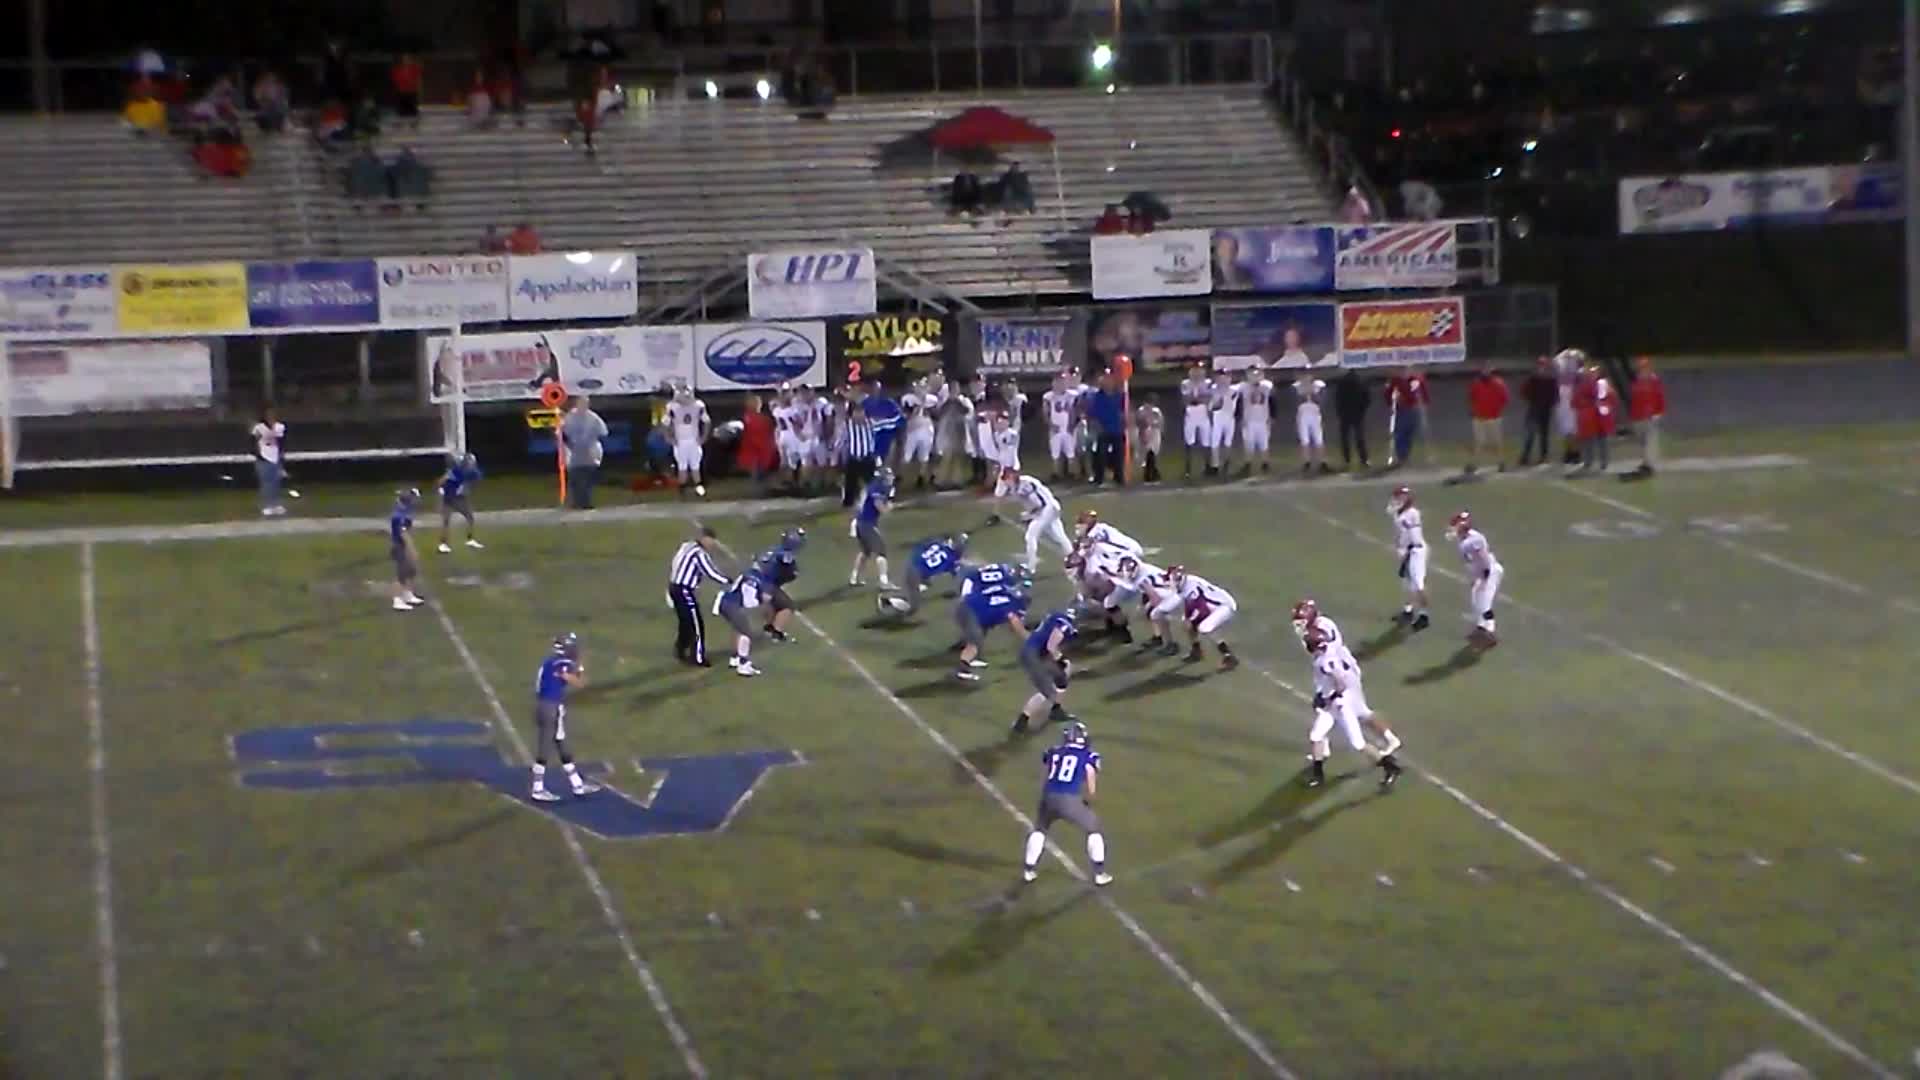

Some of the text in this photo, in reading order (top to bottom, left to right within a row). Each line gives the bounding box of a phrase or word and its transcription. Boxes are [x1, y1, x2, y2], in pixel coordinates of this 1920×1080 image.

[408, 261, 502, 277] UNITED
[1339, 252, 1452, 267] AMERICAN
[515, 275, 632, 304] Appalachian
[842, 316, 942, 341] TAYLOR
[982, 349, 1064, 366] VARNEY
[848, 361, 861, 382] 2
